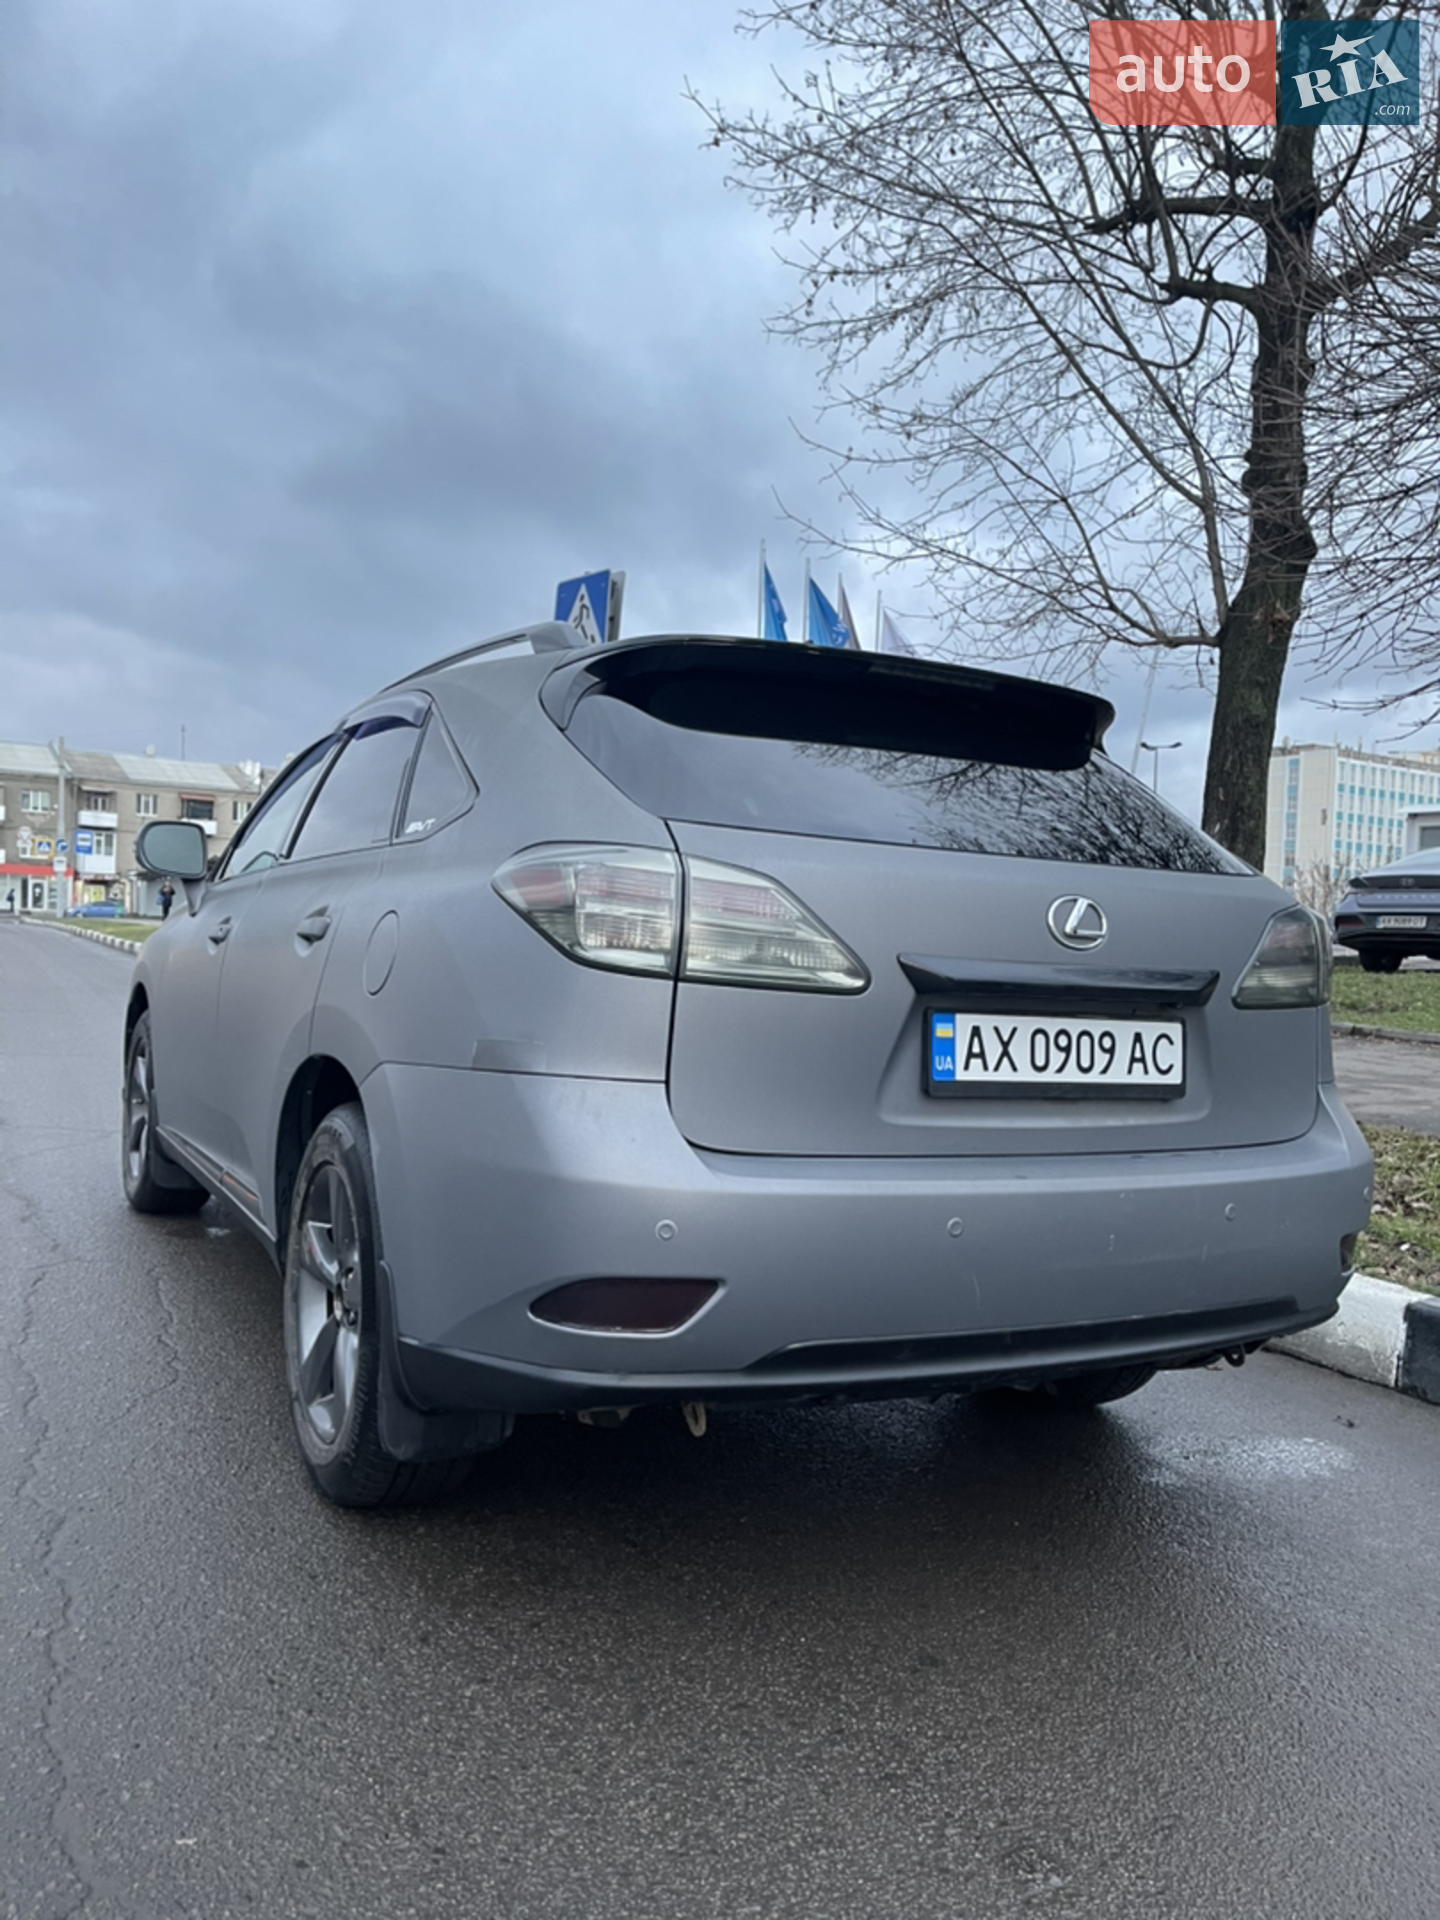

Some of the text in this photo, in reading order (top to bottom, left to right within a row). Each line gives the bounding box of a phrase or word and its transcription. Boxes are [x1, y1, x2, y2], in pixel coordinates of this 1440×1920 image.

[935, 1055, 954, 1071] UA
[963, 1025, 1175, 1076] AX 0909 AC
